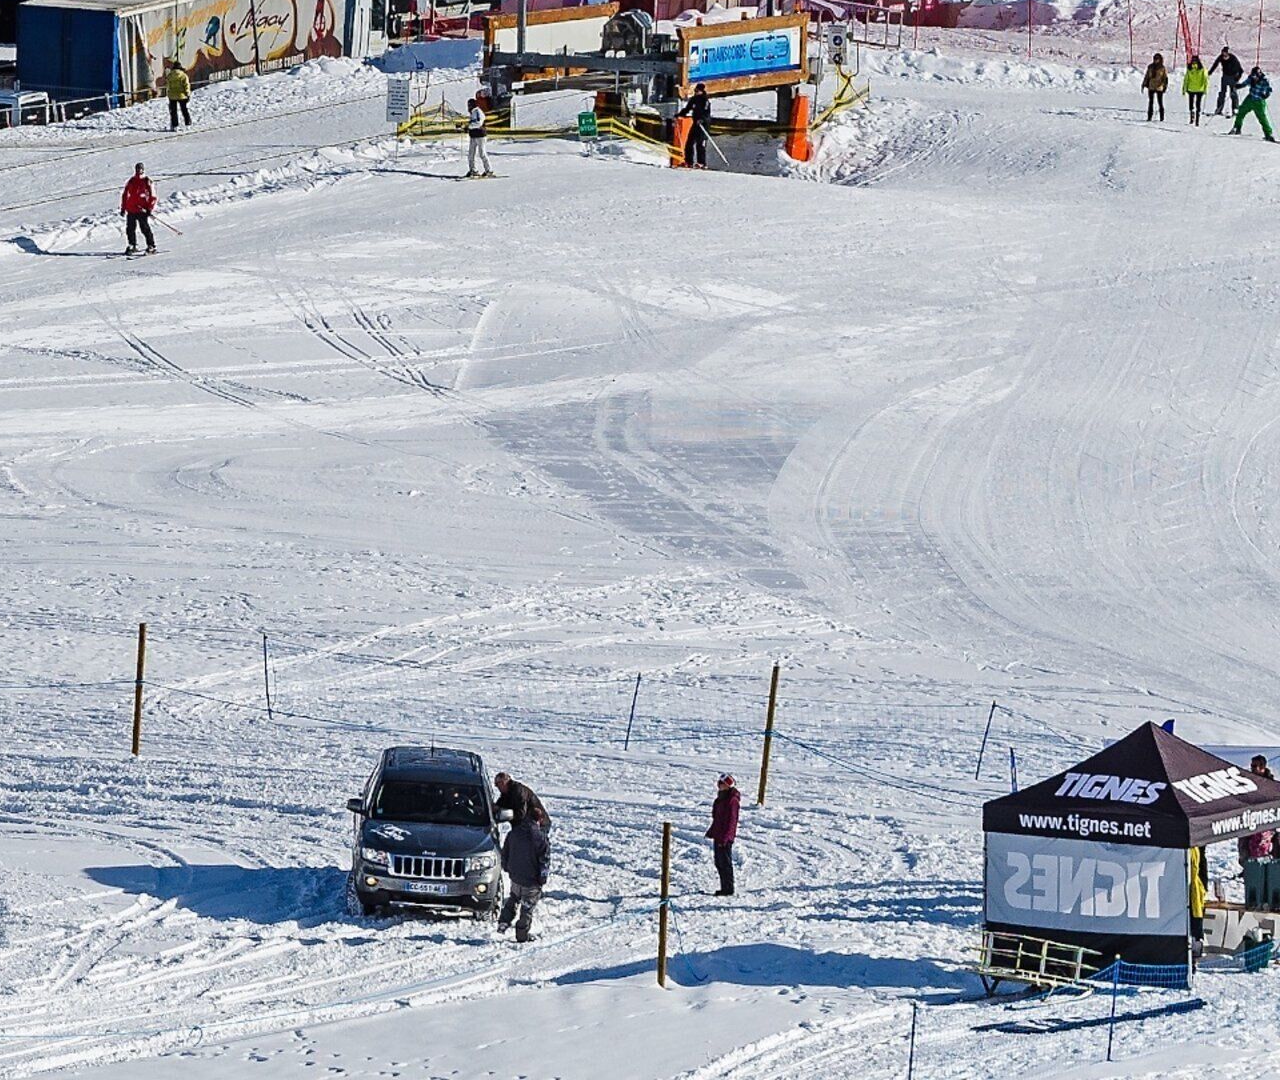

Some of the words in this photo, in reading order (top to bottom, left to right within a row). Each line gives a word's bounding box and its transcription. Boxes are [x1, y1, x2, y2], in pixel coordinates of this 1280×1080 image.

[1054, 772, 1167, 805] TIGNES
[1171, 766, 1259, 804] TIGNES
[1019, 813, 1151, 838] www.tignes.net
